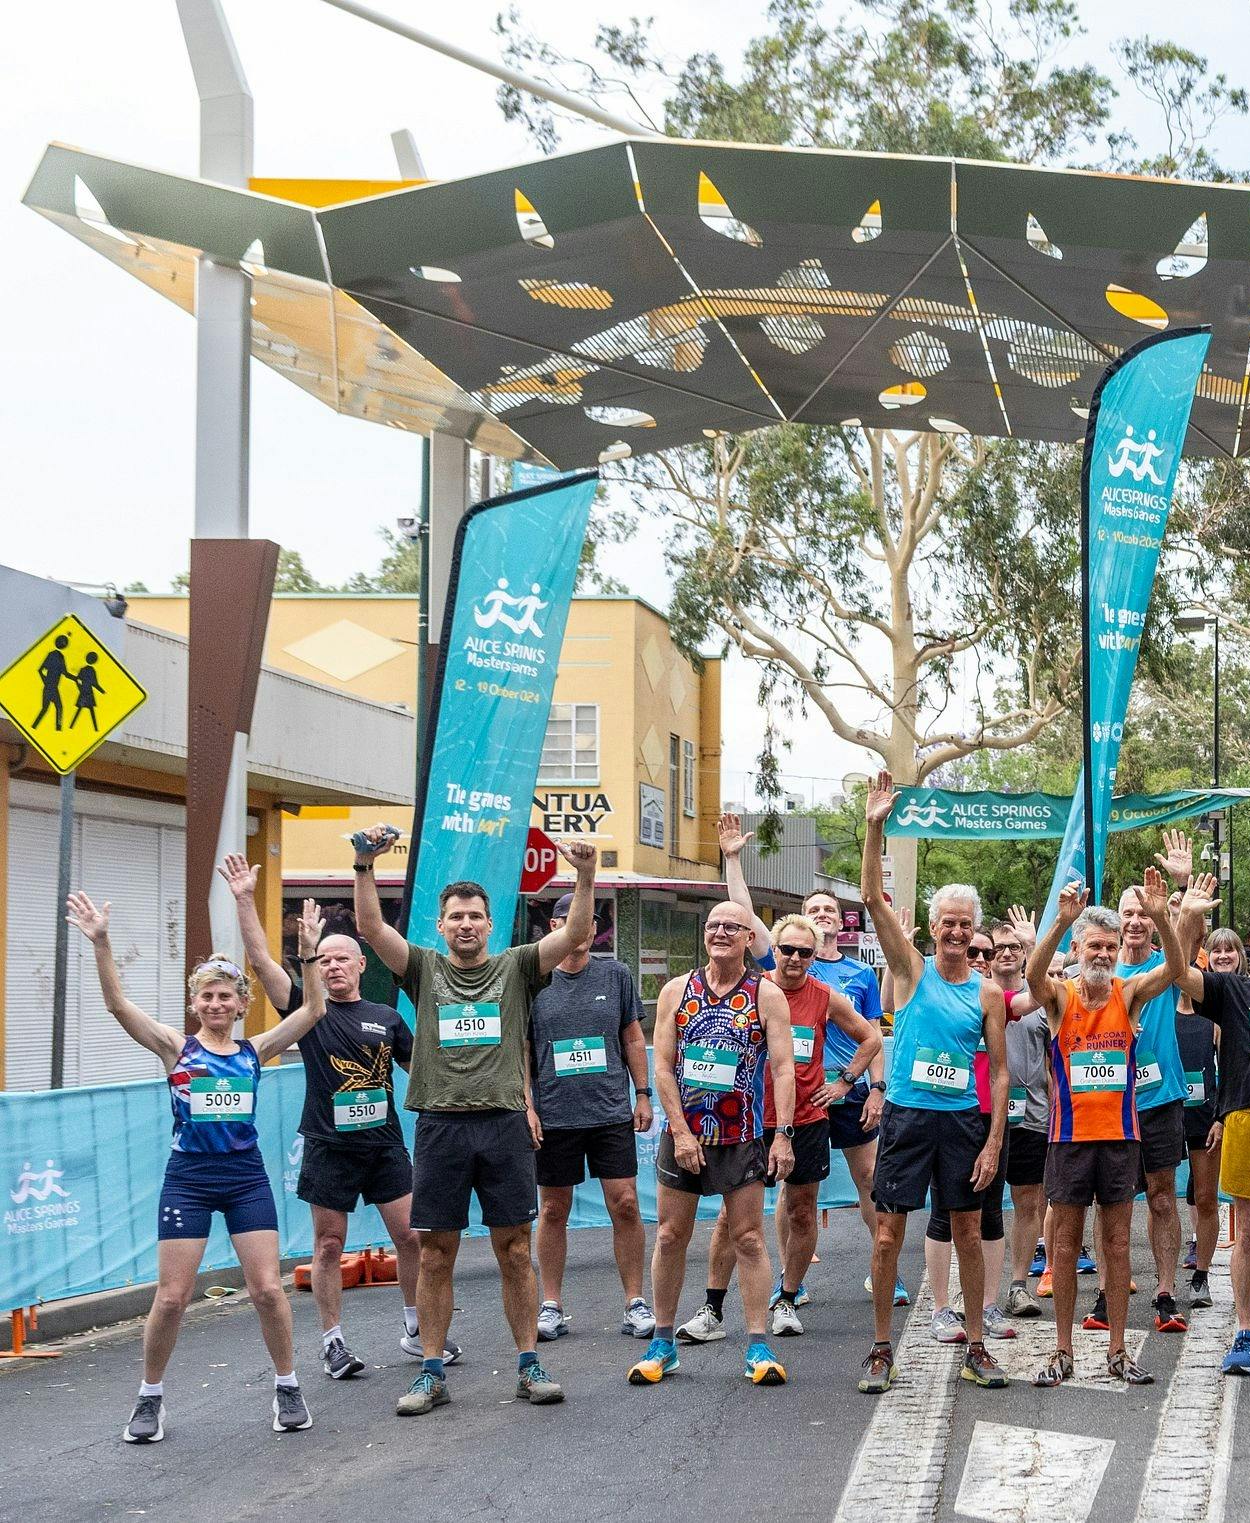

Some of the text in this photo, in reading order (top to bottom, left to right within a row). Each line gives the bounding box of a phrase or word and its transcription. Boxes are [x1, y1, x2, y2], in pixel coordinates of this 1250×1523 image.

[467, 651, 511, 671] Masters
[951, 803, 1052, 818] ALICE SPRINGS
[955, 816, 1047, 830] Masters Games
[454, 1018, 486, 1032] 4510
[1086, 1039, 1127, 1051] RUNNERS
[569, 1051, 592, 1063] 4511
[692, 1061, 715, 1072] 6017
[927, 1064, 957, 1081] 6012
[1083, 1065, 1115, 1079] 7006
[205, 1093, 241, 1107] 5009
[349, 1104, 376, 1118] 5510
[4, 1200, 81, 1224] ALICE SPRINGS
